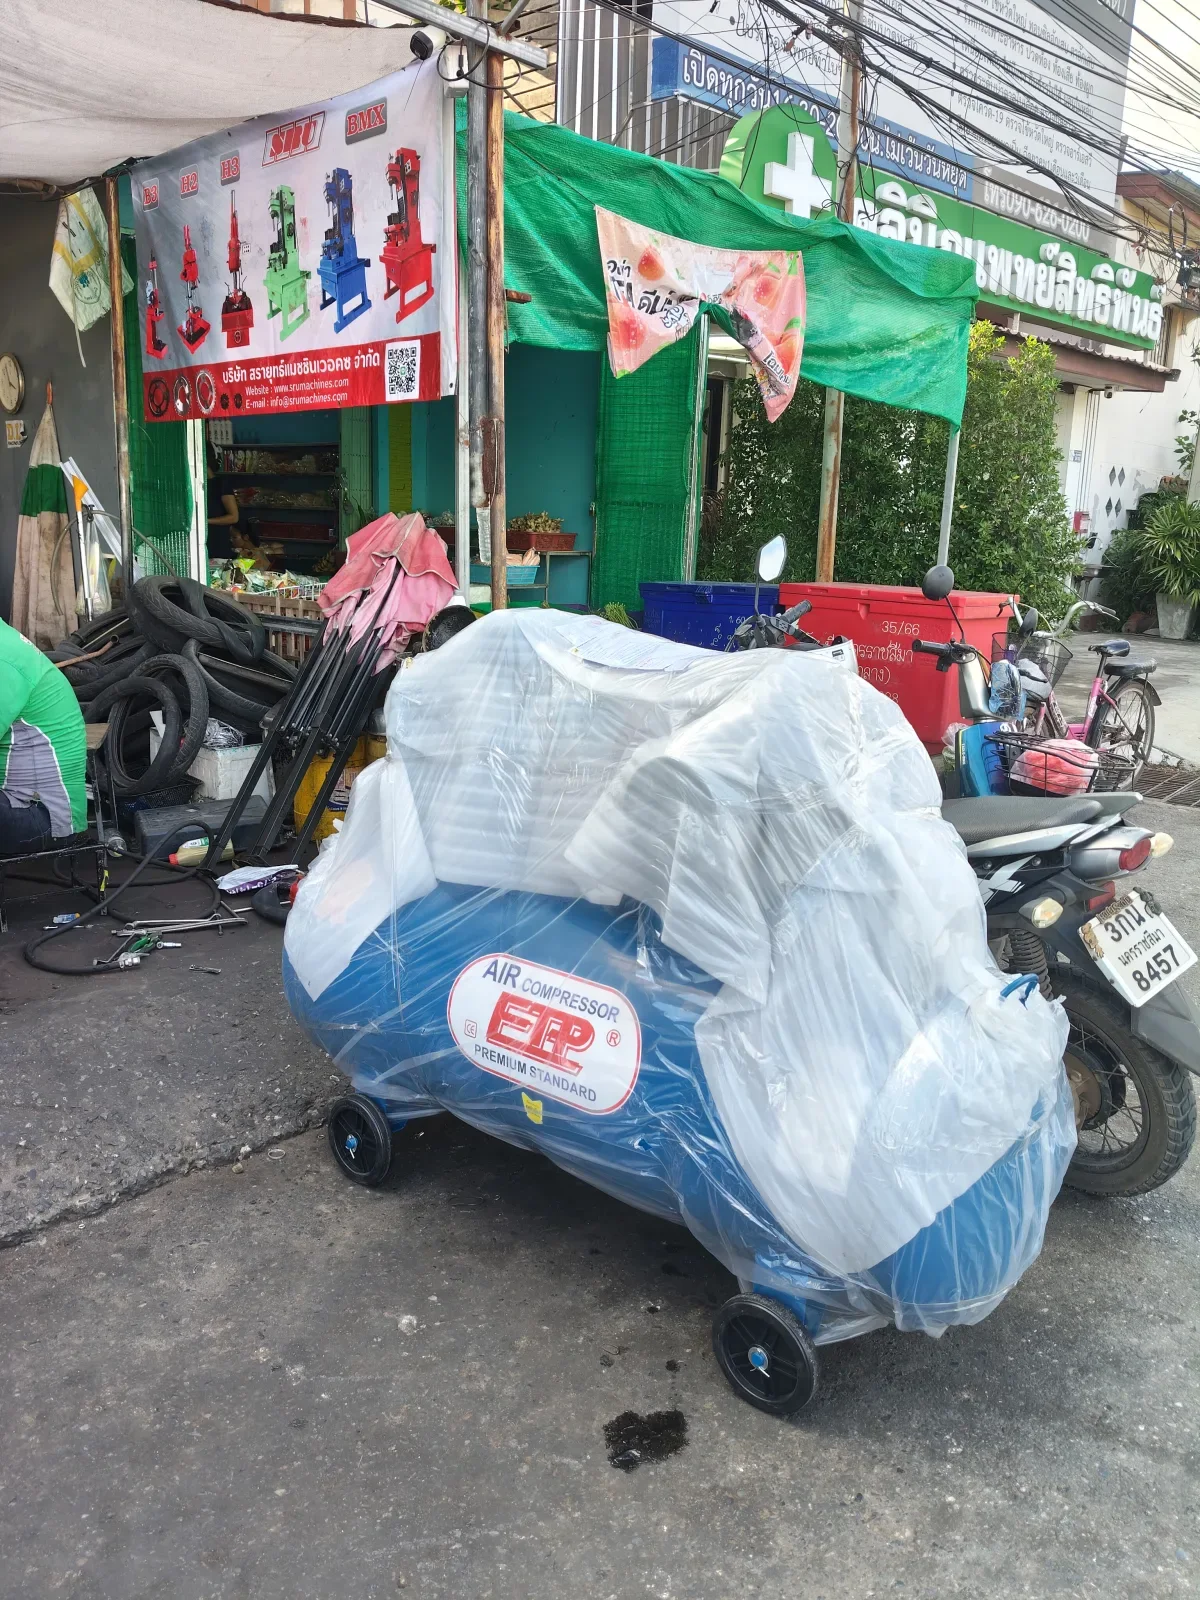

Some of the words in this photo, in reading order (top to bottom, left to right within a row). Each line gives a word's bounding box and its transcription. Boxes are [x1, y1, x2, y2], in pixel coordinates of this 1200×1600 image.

[346, 102, 386, 137] BMX
[180, 171, 199, 195] H2
[220, 155, 240, 181] H3
[143, 184, 158, 206] B3
[222, 365, 248, 384] บริษัท
[353, 348, 381, 370] จำกัด
[245, 385, 270, 397] Website
[274, 377, 350, 395] www.srumachines.com
[245, 398, 266, 410] E-mail
[270, 391, 349, 409] info@srumachines.com
[881, 620, 920, 636] 35/66
[1103, 904, 1146, 943] 3กน
[1118, 928, 1166, 967] นครราชสีมา
[1131, 943, 1180, 992] 8457
[482, 959, 522, 989] AIR
[521, 977, 621, 1024] COMPRESSOR
[474, 1043, 528, 1076] PREMIUM
[528, 1065, 597, 1103] STANDARD
